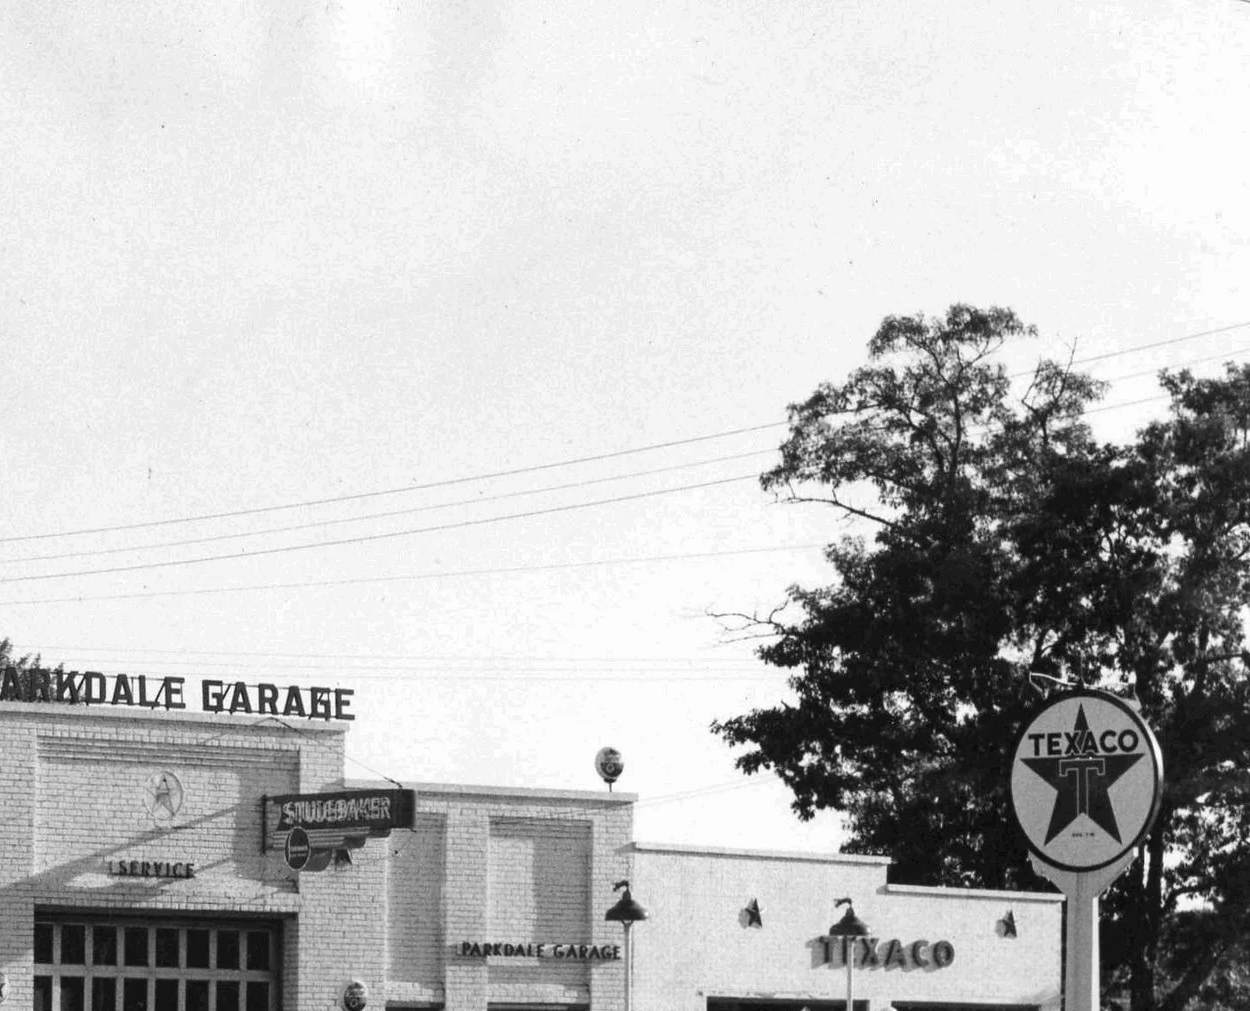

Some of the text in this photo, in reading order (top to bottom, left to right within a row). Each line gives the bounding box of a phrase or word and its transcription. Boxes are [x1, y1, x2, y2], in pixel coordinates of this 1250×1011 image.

[202, 679, 355, 720] GARAGE
[1028, 729, 1139, 756] TEXACO
[282, 796, 392, 824] STUDEBAKER
[118, 860, 196, 878] SERVICE
[462, 941, 622, 960] PARKDALE GARAGE
